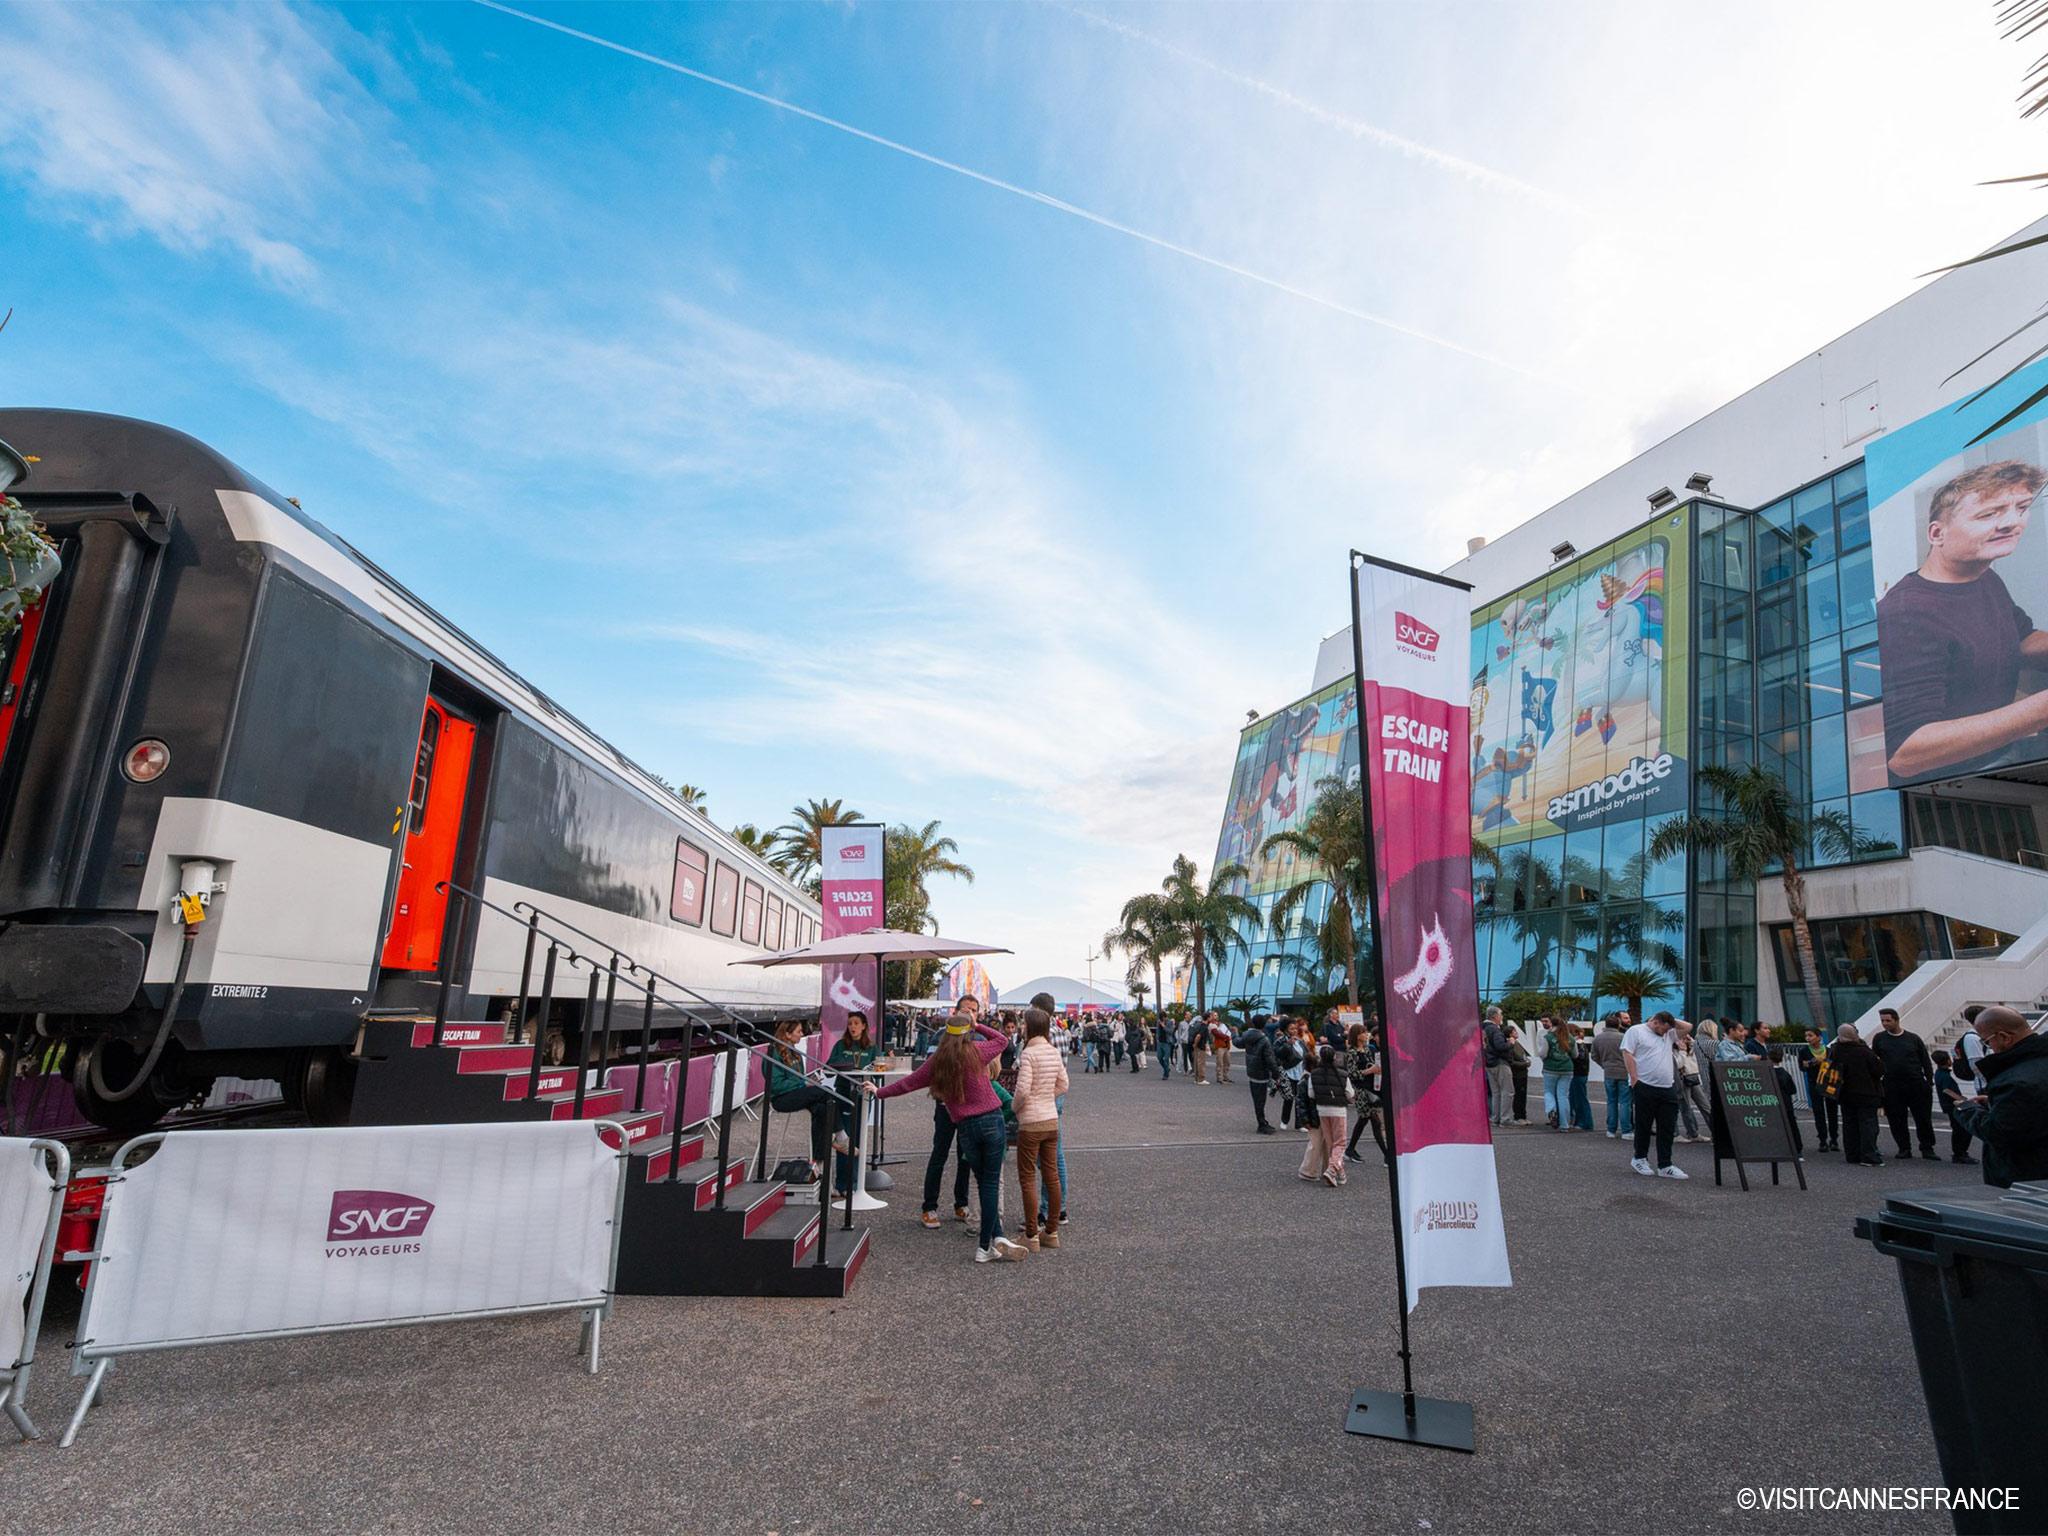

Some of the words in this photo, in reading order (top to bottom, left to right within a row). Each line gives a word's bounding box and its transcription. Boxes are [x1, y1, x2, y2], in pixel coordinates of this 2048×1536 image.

[1398, 624, 1437, 646] SNCF
[1396, 644, 1436, 662] VOYAGEURS
[1382, 715, 1449, 753] ESCAPE
[1383, 748, 1442, 784] TRAIN
[1546, 753, 1673, 820] asmodee
[1577, 802, 1612, 822] Inspired
[1614, 799, 1626, 808] by
[1626, 785, 1661, 803] Players
[211, 984, 261, 998] EXTREMITE
[260, 986, 268, 998] 2
[332, 1206, 428, 1235] SNCF
[325, 1243, 421, 1259] VOYAGEURS
